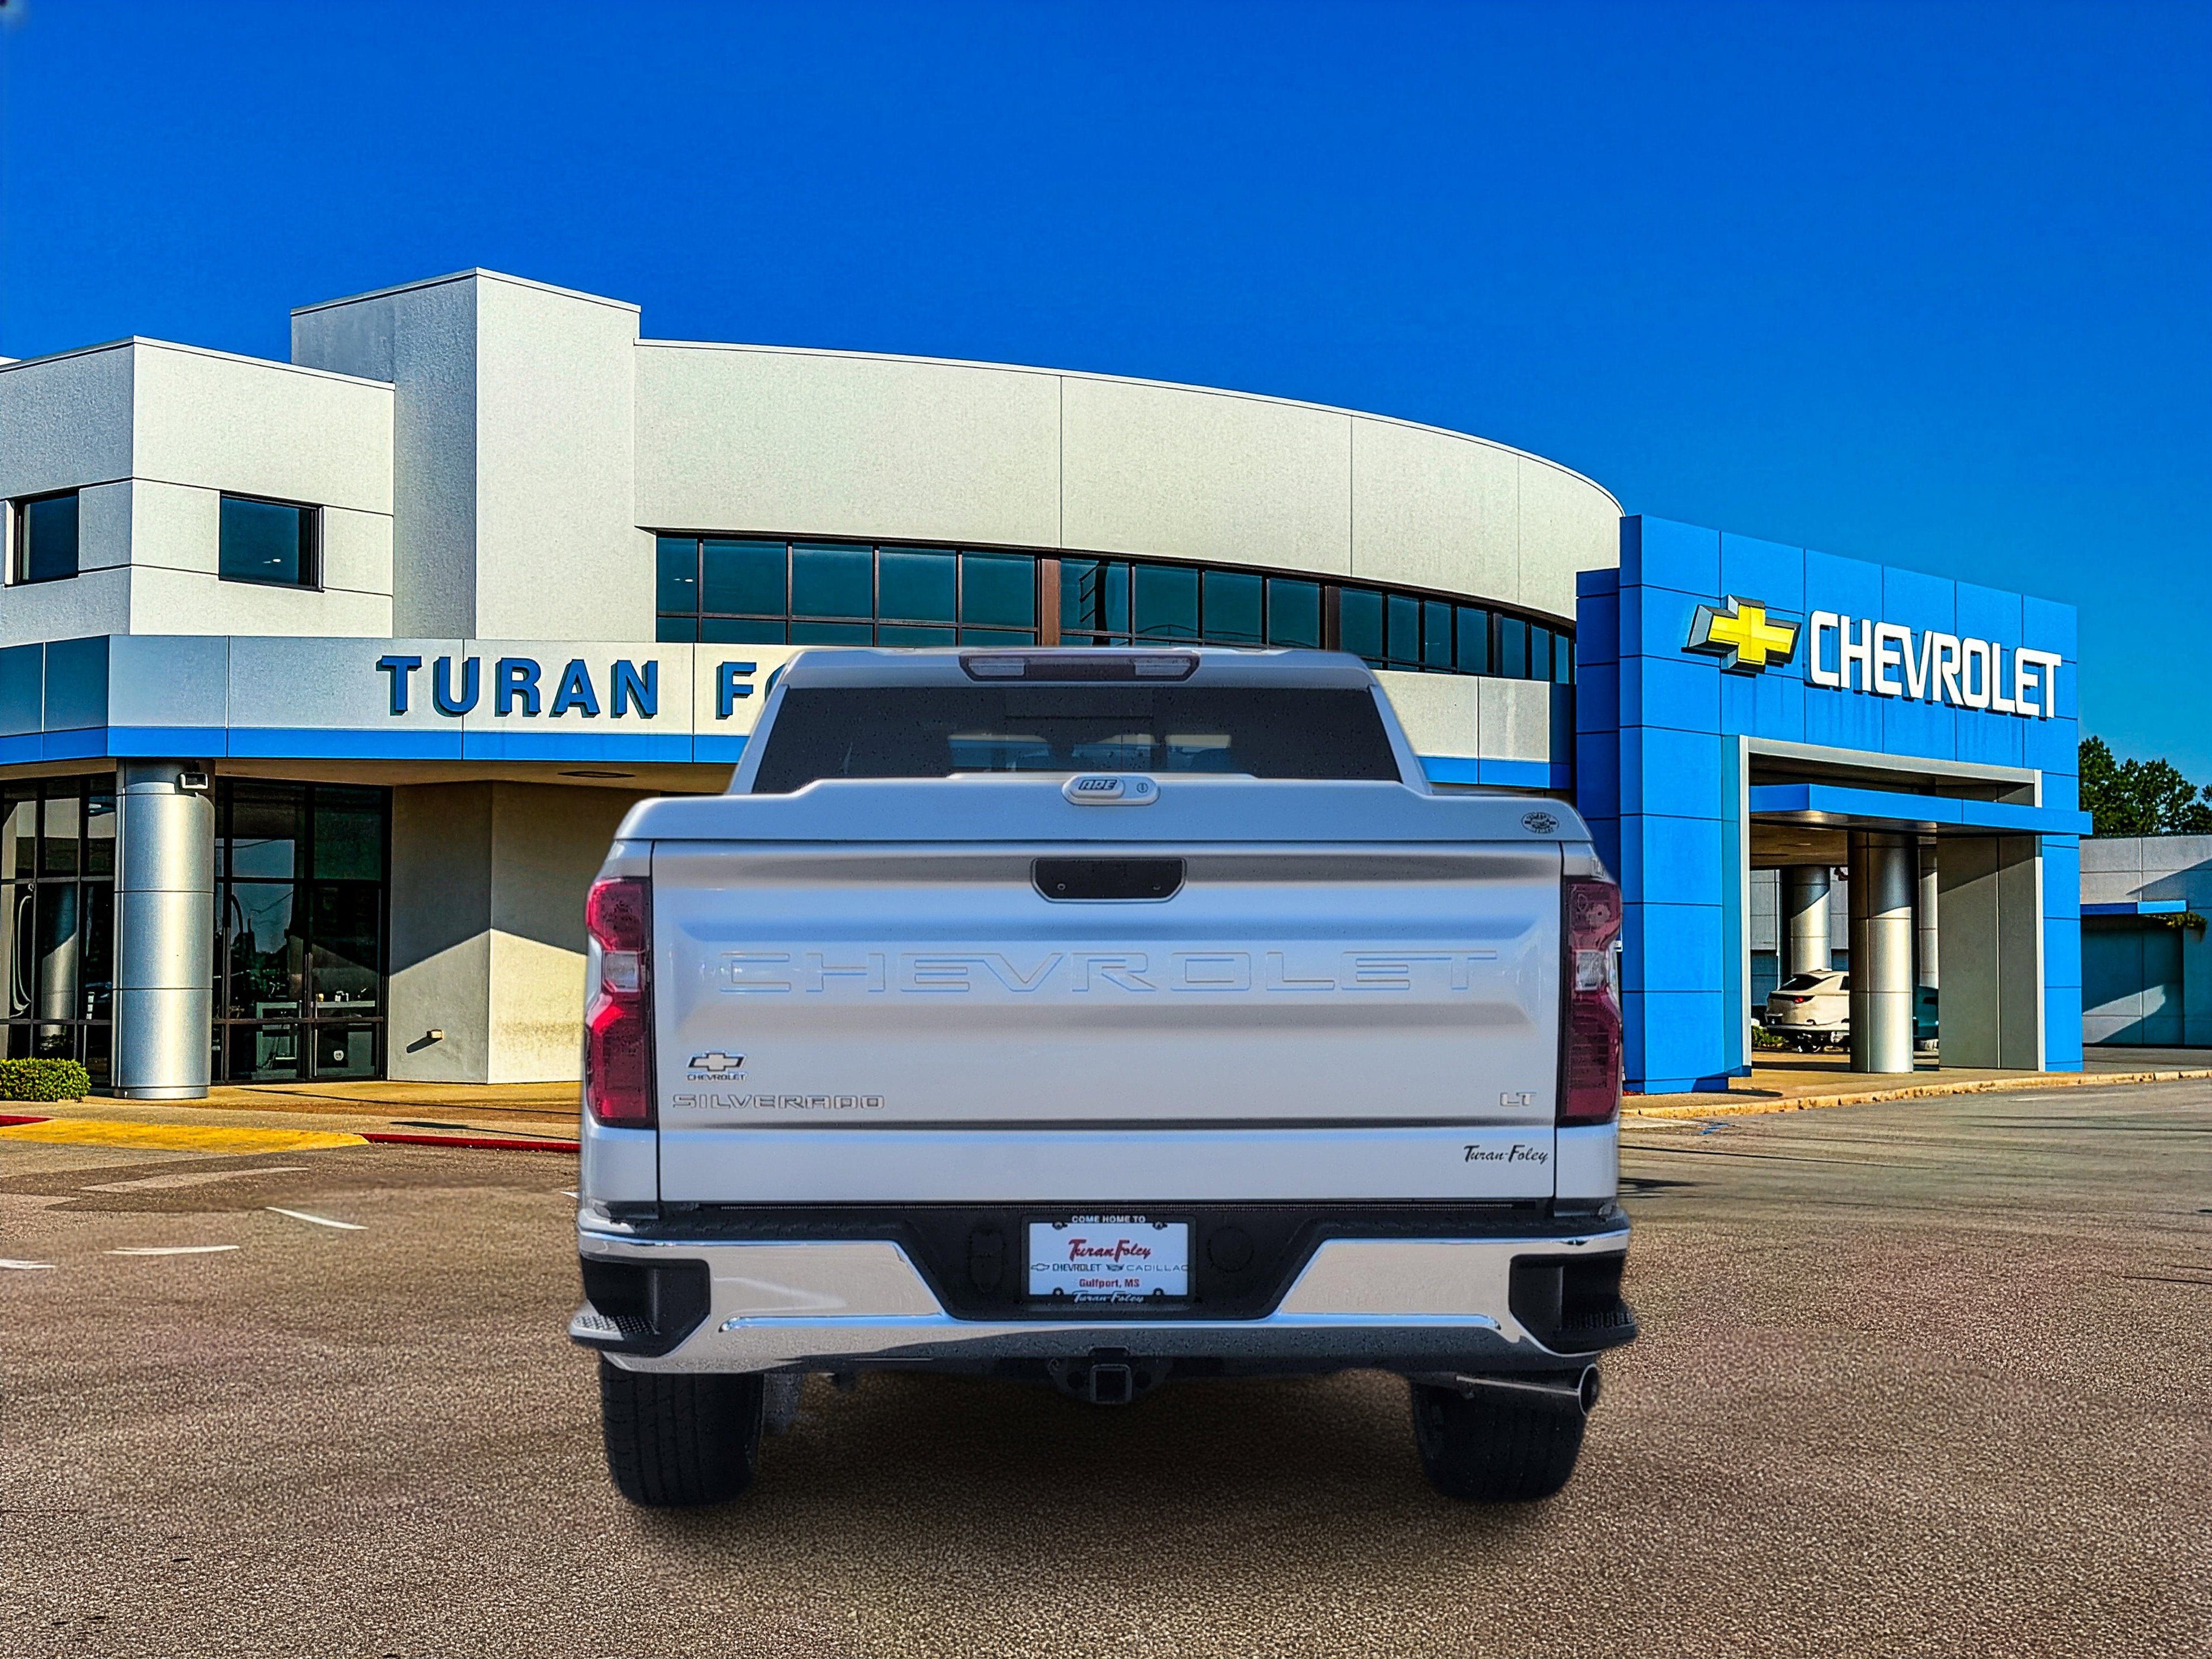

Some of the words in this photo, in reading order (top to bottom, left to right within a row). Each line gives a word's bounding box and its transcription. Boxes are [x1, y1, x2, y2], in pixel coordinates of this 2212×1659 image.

[1809, 610, 2062, 719] CHEVROLET
[376, 655, 659, 719] TURAN
[1078, 779, 1117, 790] ARE
[718, 950, 1497, 992] CHEVROLET
[686, 1072, 746, 1081] CHEVROLET
[672, 1094, 885, 1109] SILVERADO
[1500, 1091, 1536, 1107] LT
[1079, 1278, 1122, 1288] Gulfport,
[1124, 1278, 1140, 1287] MS
